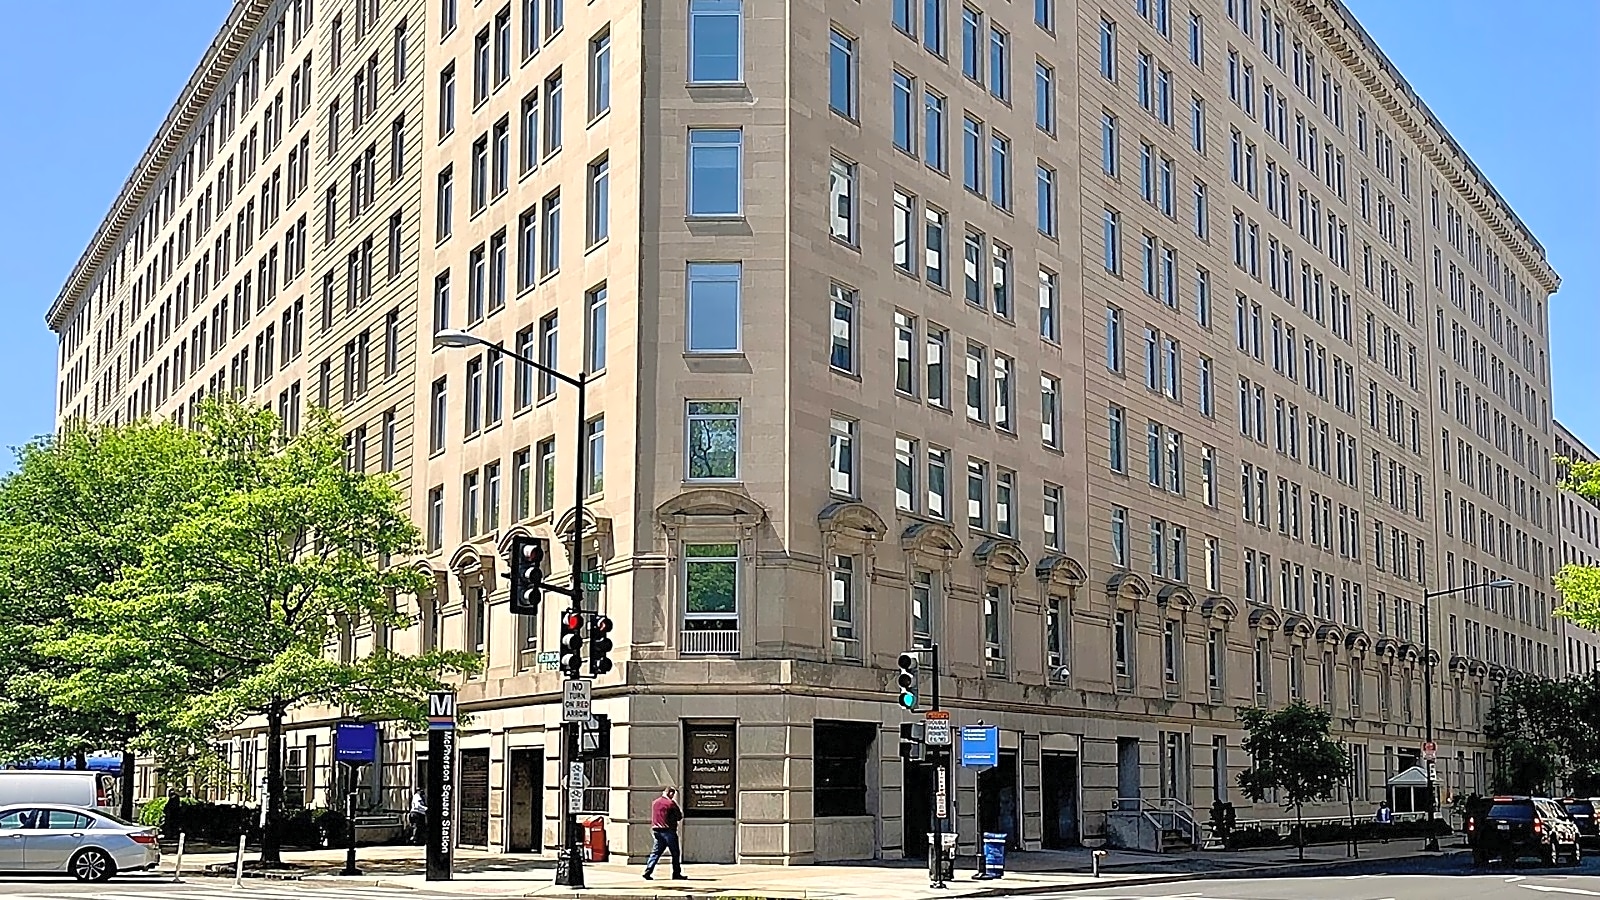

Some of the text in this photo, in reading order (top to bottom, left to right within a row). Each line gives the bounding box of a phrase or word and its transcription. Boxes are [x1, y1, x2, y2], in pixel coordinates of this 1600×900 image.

[572, 682, 583, 691] NO
[569, 692, 586, 700] TURN
[430, 694, 452, 716] M
[576, 700, 589, 708] RED
[566, 709, 588, 717] ARROW
[441, 731, 452, 854] McPherson Square Station
